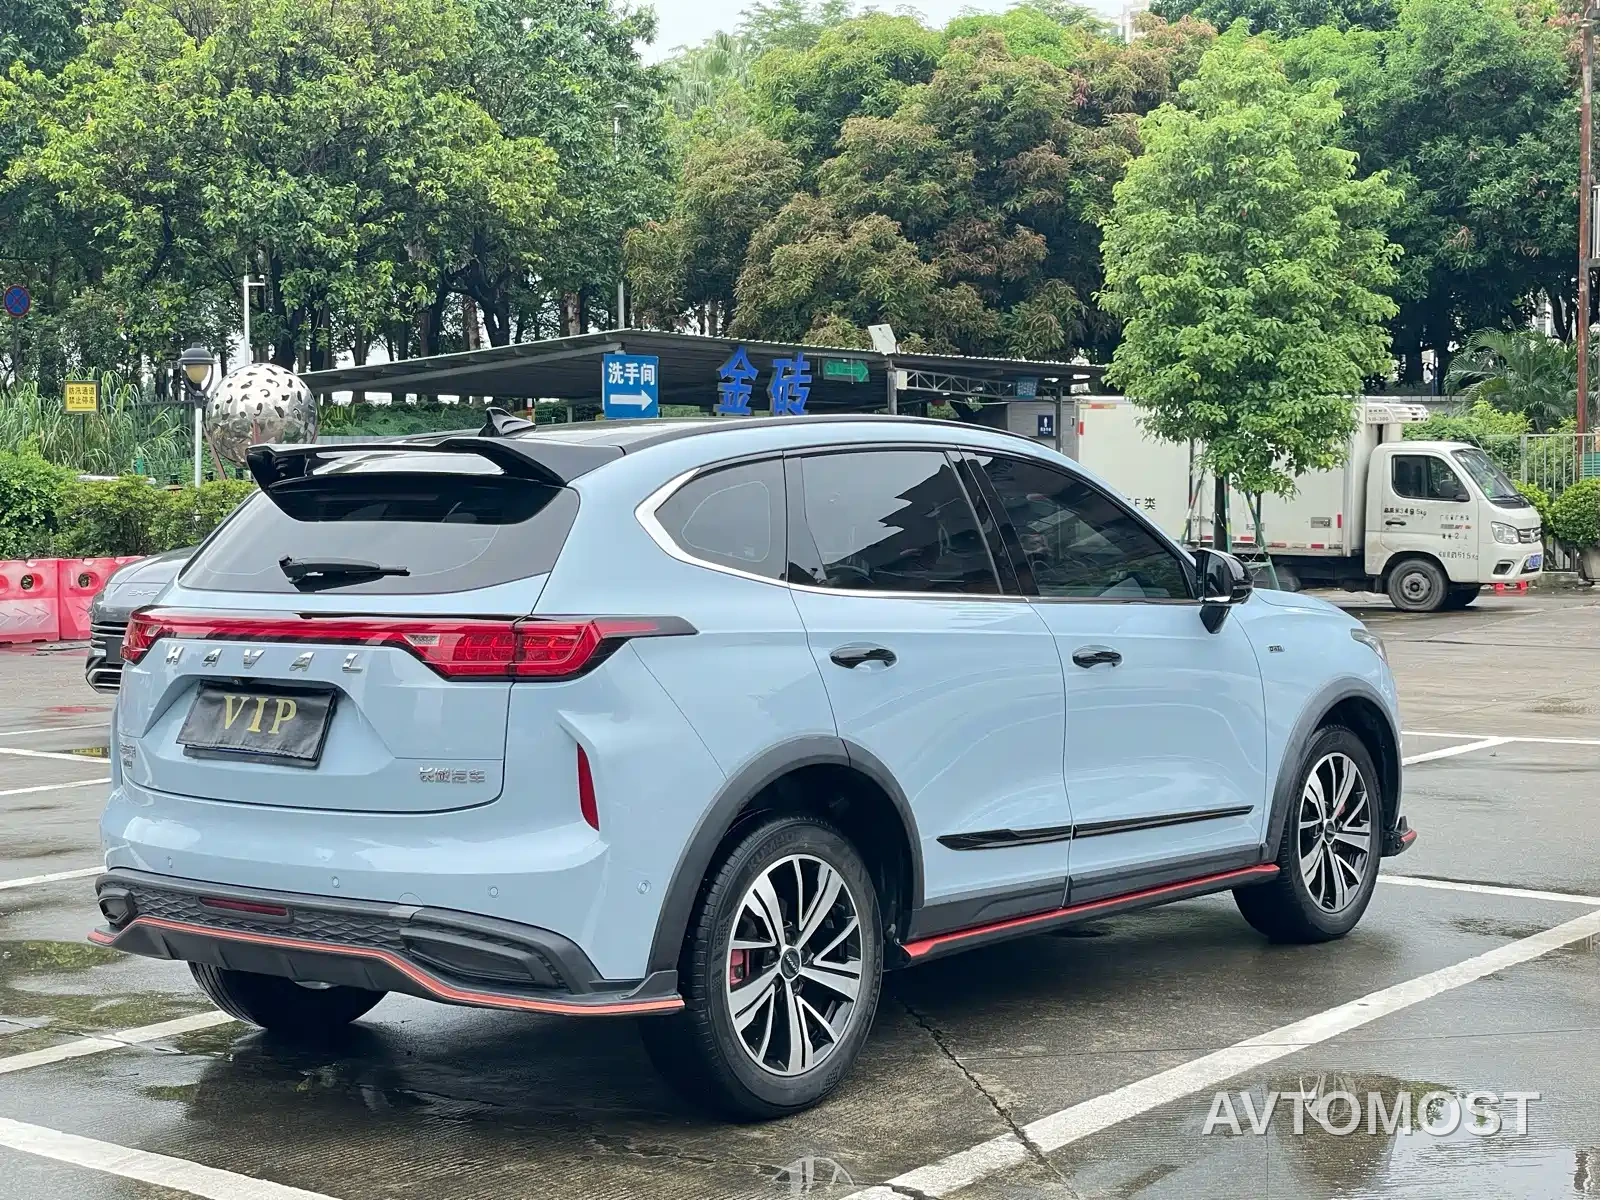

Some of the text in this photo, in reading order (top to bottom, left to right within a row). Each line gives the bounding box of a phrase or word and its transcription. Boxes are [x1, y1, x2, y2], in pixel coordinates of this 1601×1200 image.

[608, 362, 656, 385] 洗手间
[715, 345, 813, 416] 金砖
[166, 646, 364, 674] HAVAL
[223, 695, 298, 734] VIP
